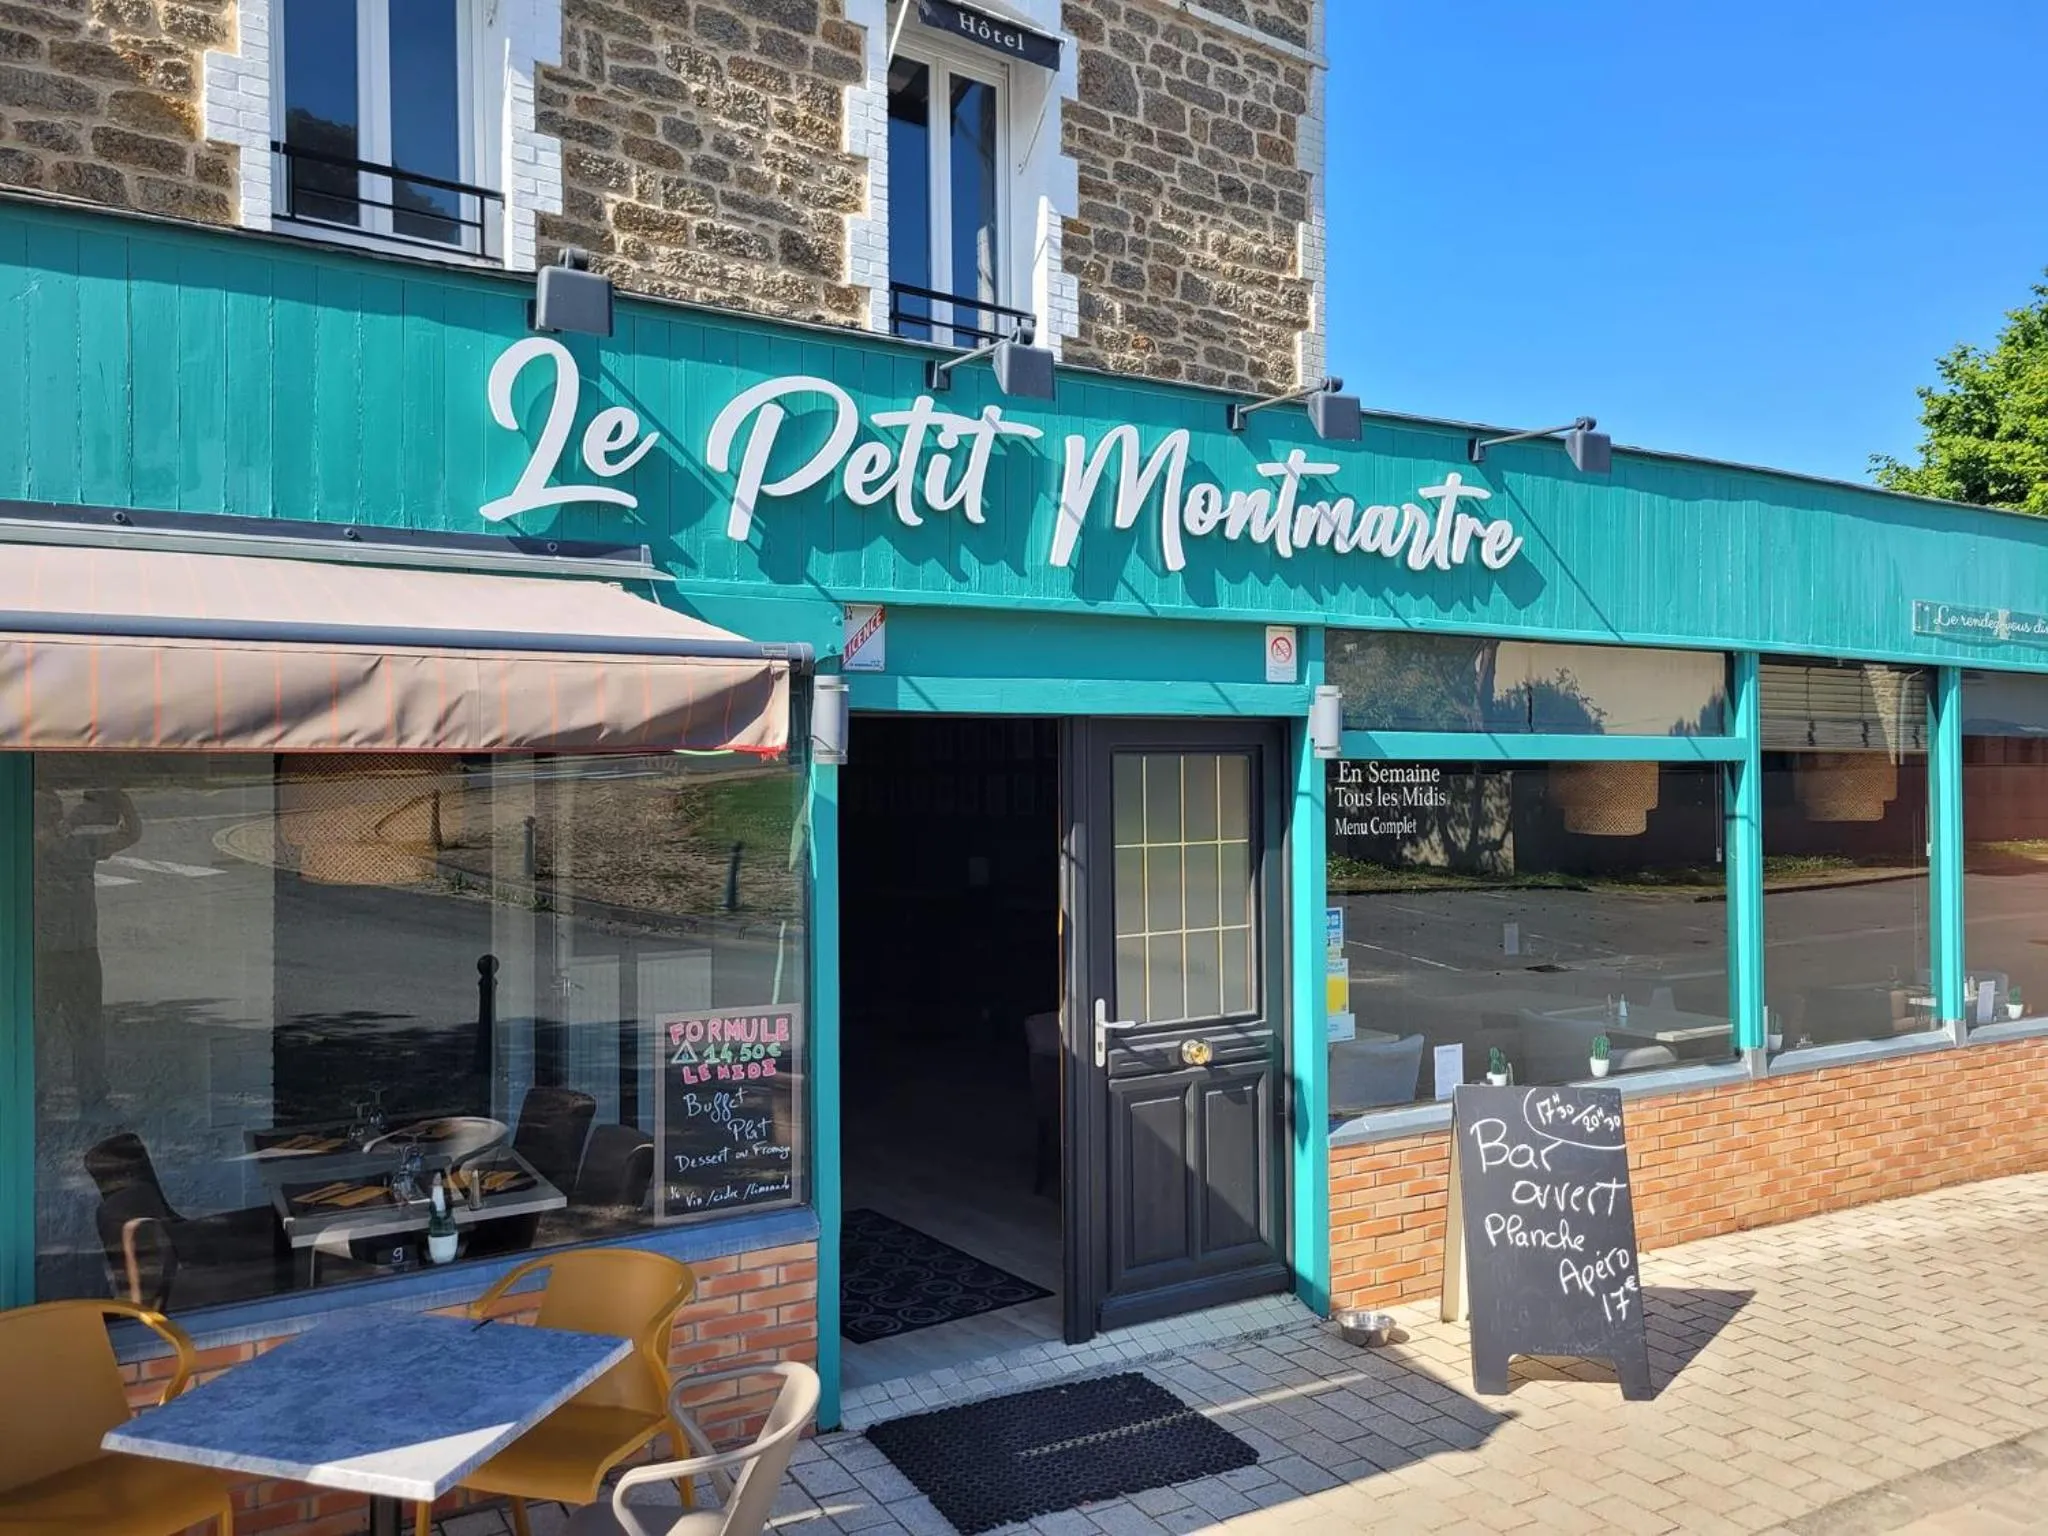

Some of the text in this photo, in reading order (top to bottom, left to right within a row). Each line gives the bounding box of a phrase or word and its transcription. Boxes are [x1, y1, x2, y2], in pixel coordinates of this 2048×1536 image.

[958, 12, 1025, 51] Hôtel
[479, 336, 1524, 573] Le Petit Montmartre
[1960, 611, 2031, 640] rendezvous
[1338, 760, 1440, 783] En Semaine
[1334, 786, 1446, 807] Tous les Midis
[1335, 816, 1417, 840] Menu Complet
[669, 1017, 790, 1046] FORMULE
[682, 1063, 712, 1085] LE
[683, 1087, 748, 1122] Buffet
[727, 1117, 772, 1141] Plat
[1469, 1117, 1562, 1173] Bar
[674, 1146, 730, 1173] Dessert
